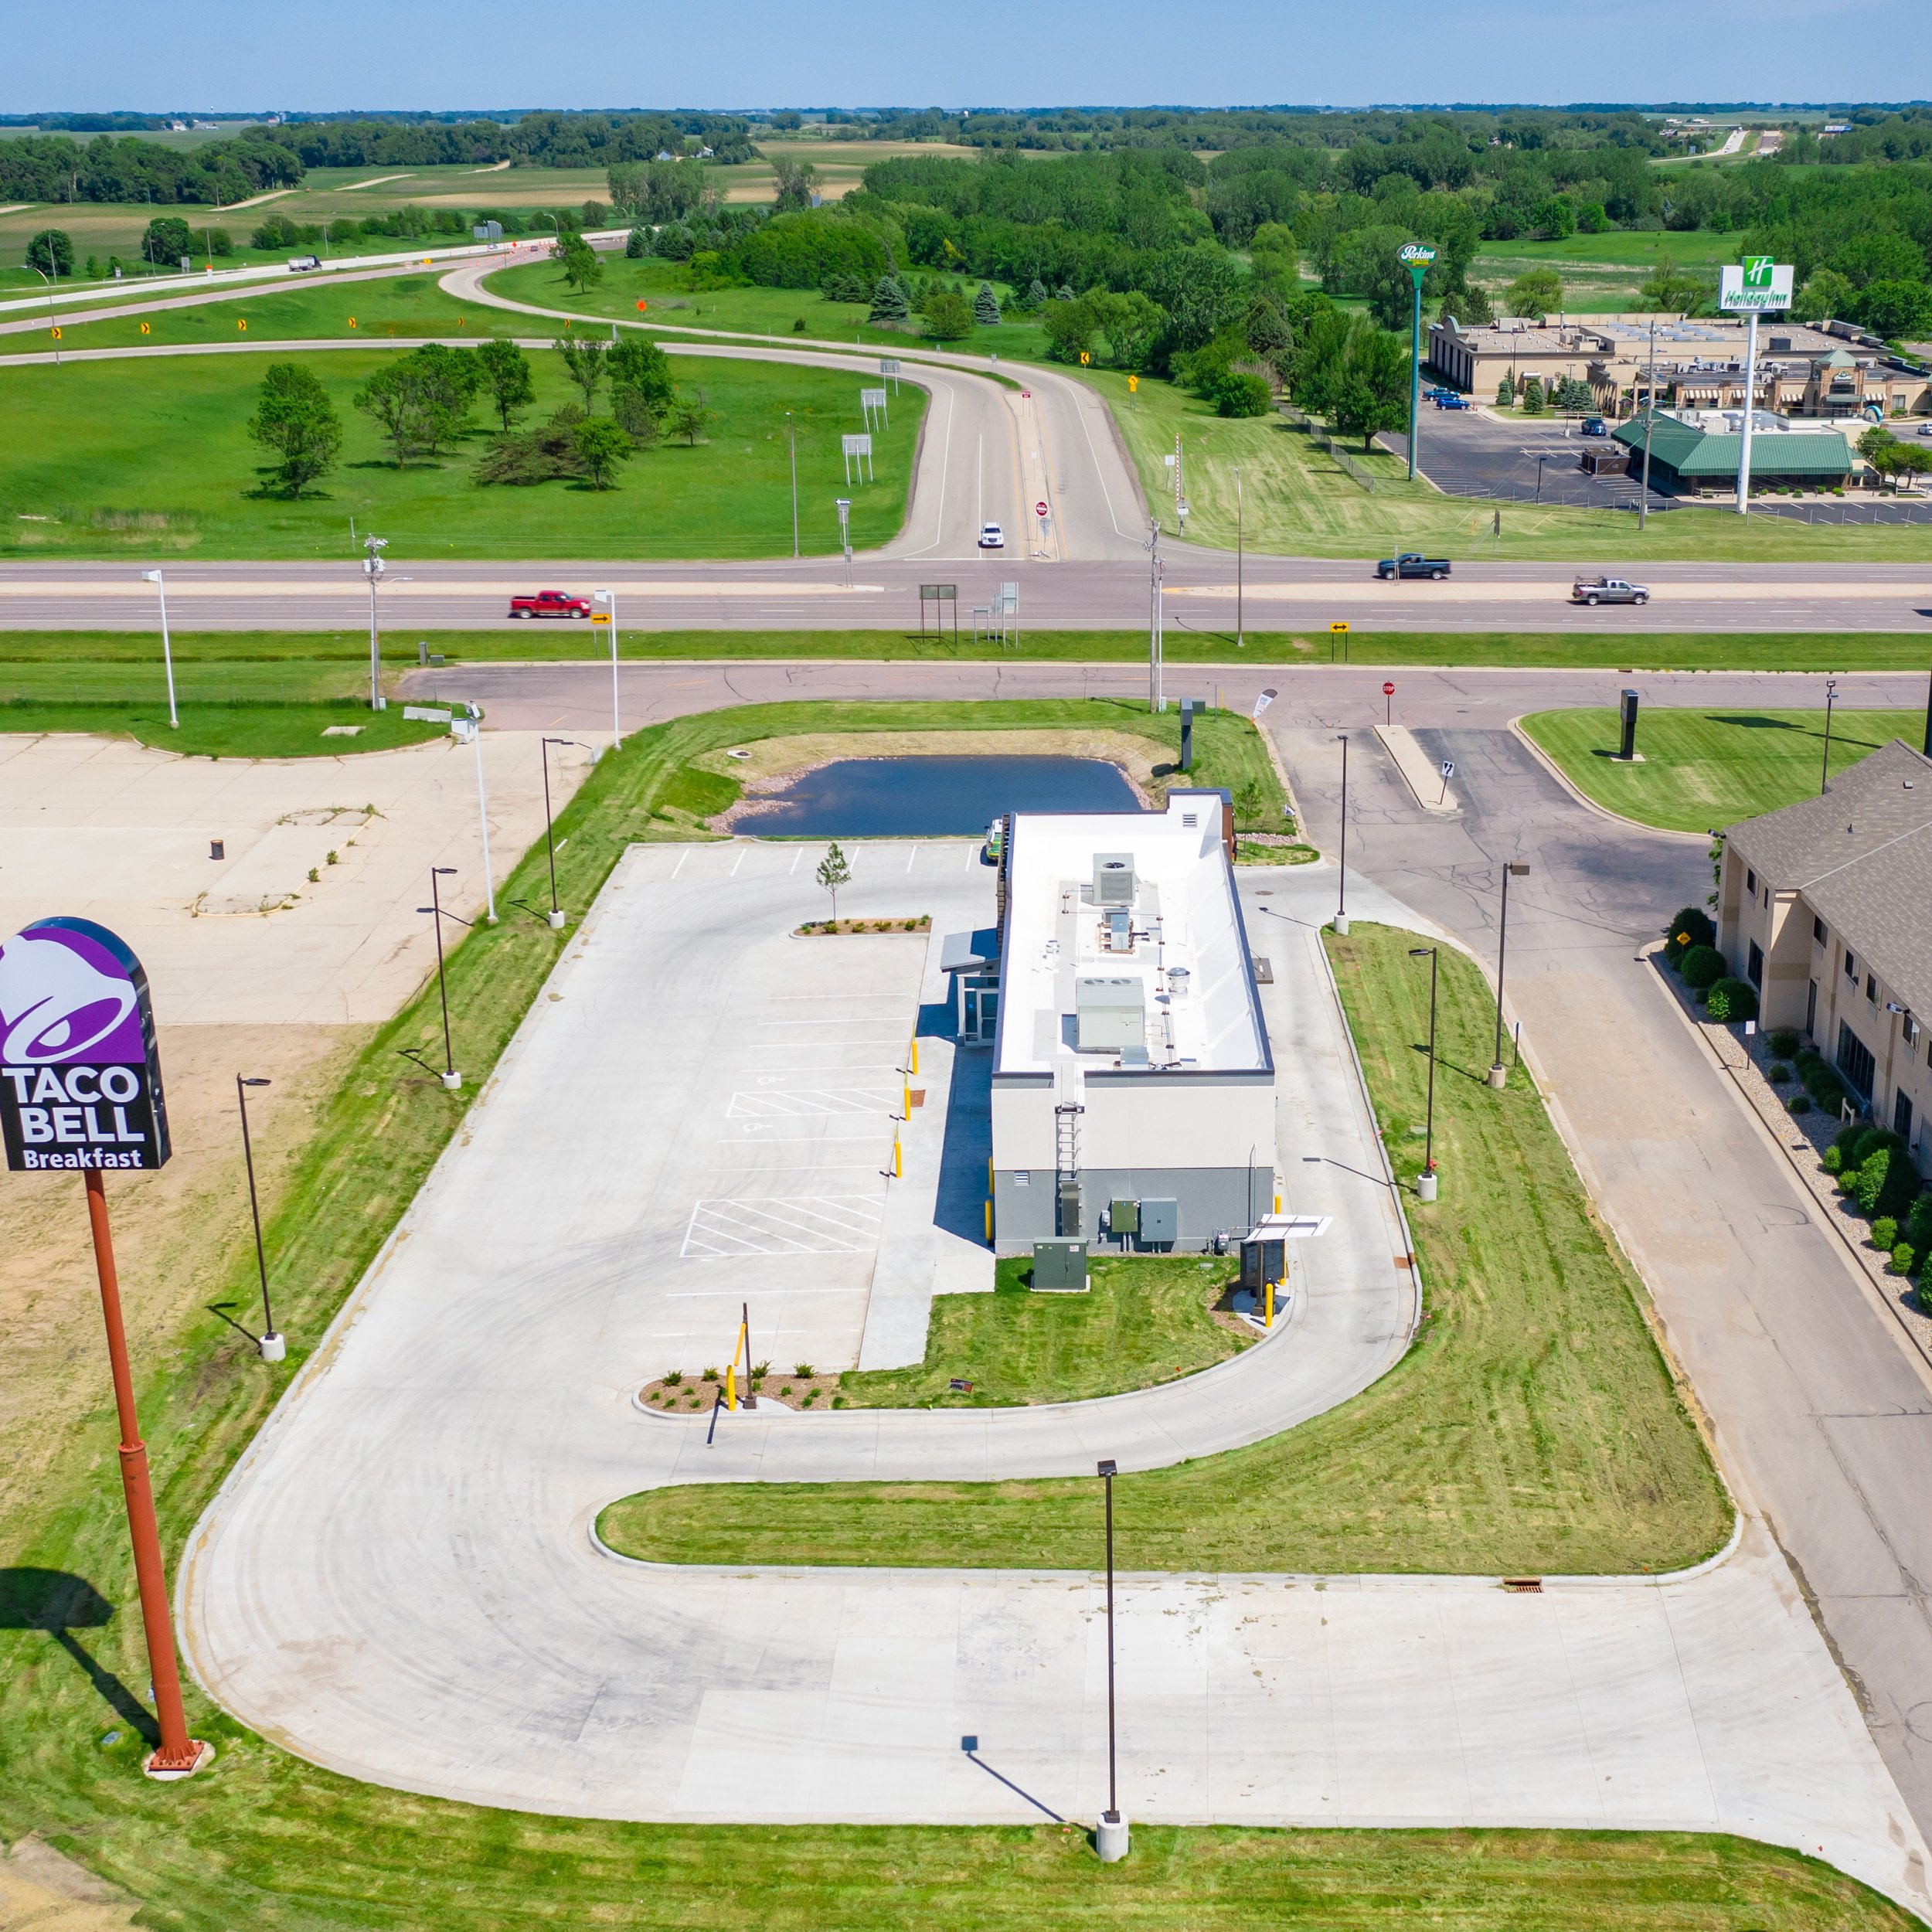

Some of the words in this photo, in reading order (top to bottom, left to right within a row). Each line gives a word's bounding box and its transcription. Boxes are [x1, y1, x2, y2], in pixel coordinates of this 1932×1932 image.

[1401, 245, 1436, 260] Perkins
[1725, 291, 1768, 304] Holiday
[1768, 291, 1788, 304] Inn
[2, 1066, 139, 1103] TACO
[19, 1107, 145, 1143] BELL
[23, 1148, 142, 1168] Breakfast
